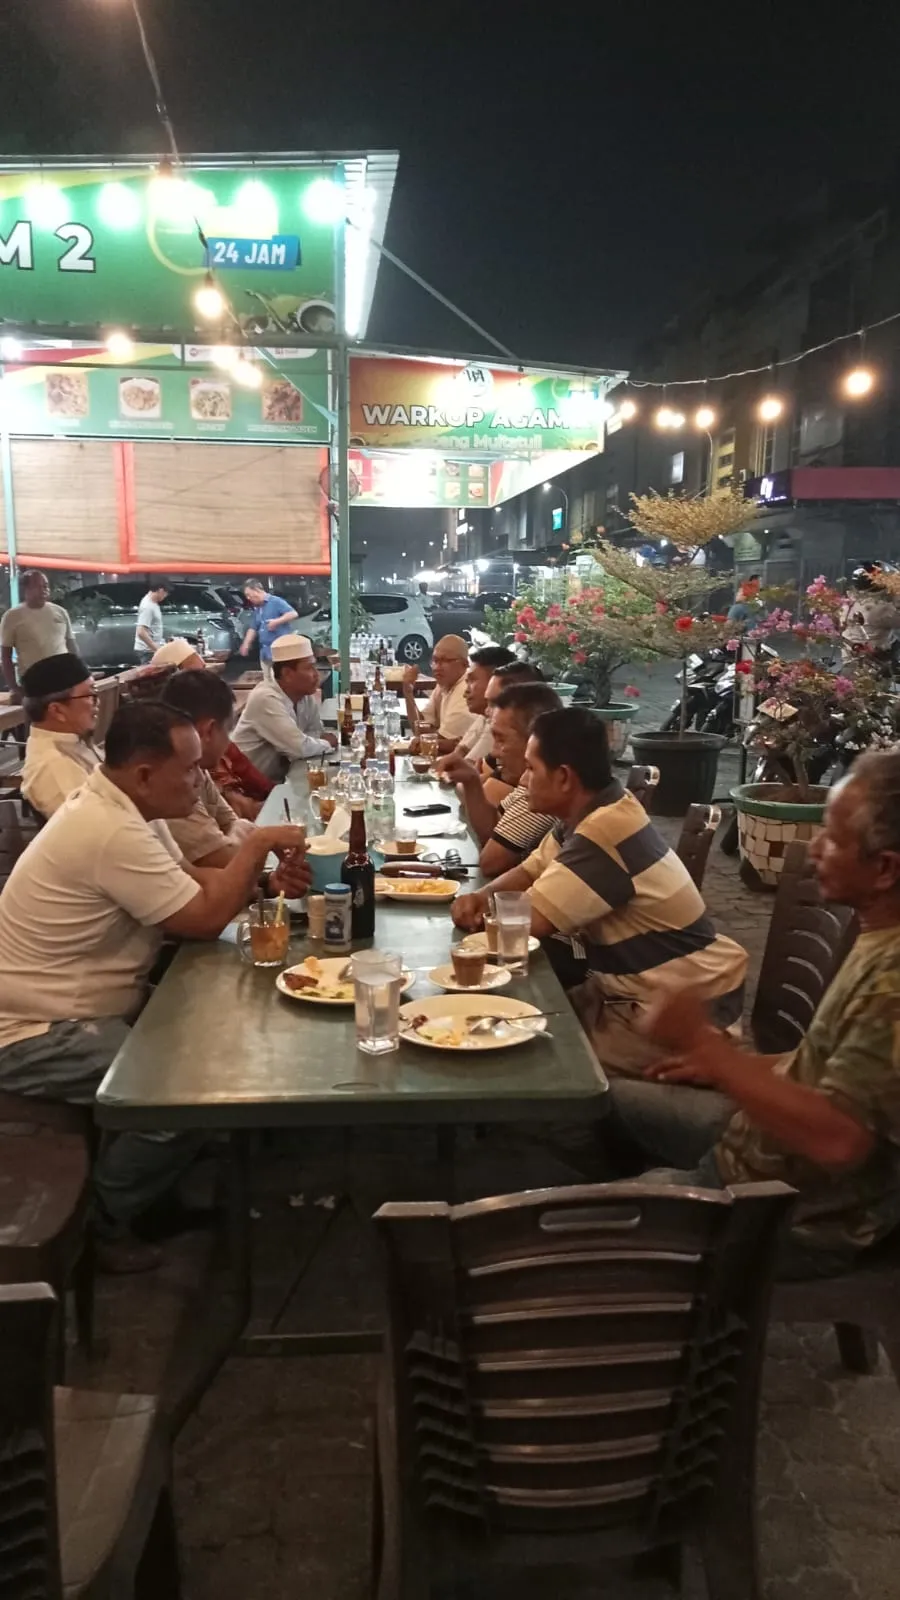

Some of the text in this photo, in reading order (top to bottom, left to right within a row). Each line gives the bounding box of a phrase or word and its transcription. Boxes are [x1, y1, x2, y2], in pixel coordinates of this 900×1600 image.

[54, 222, 96, 273] 2
[213, 241, 287, 265] 24 JAM
